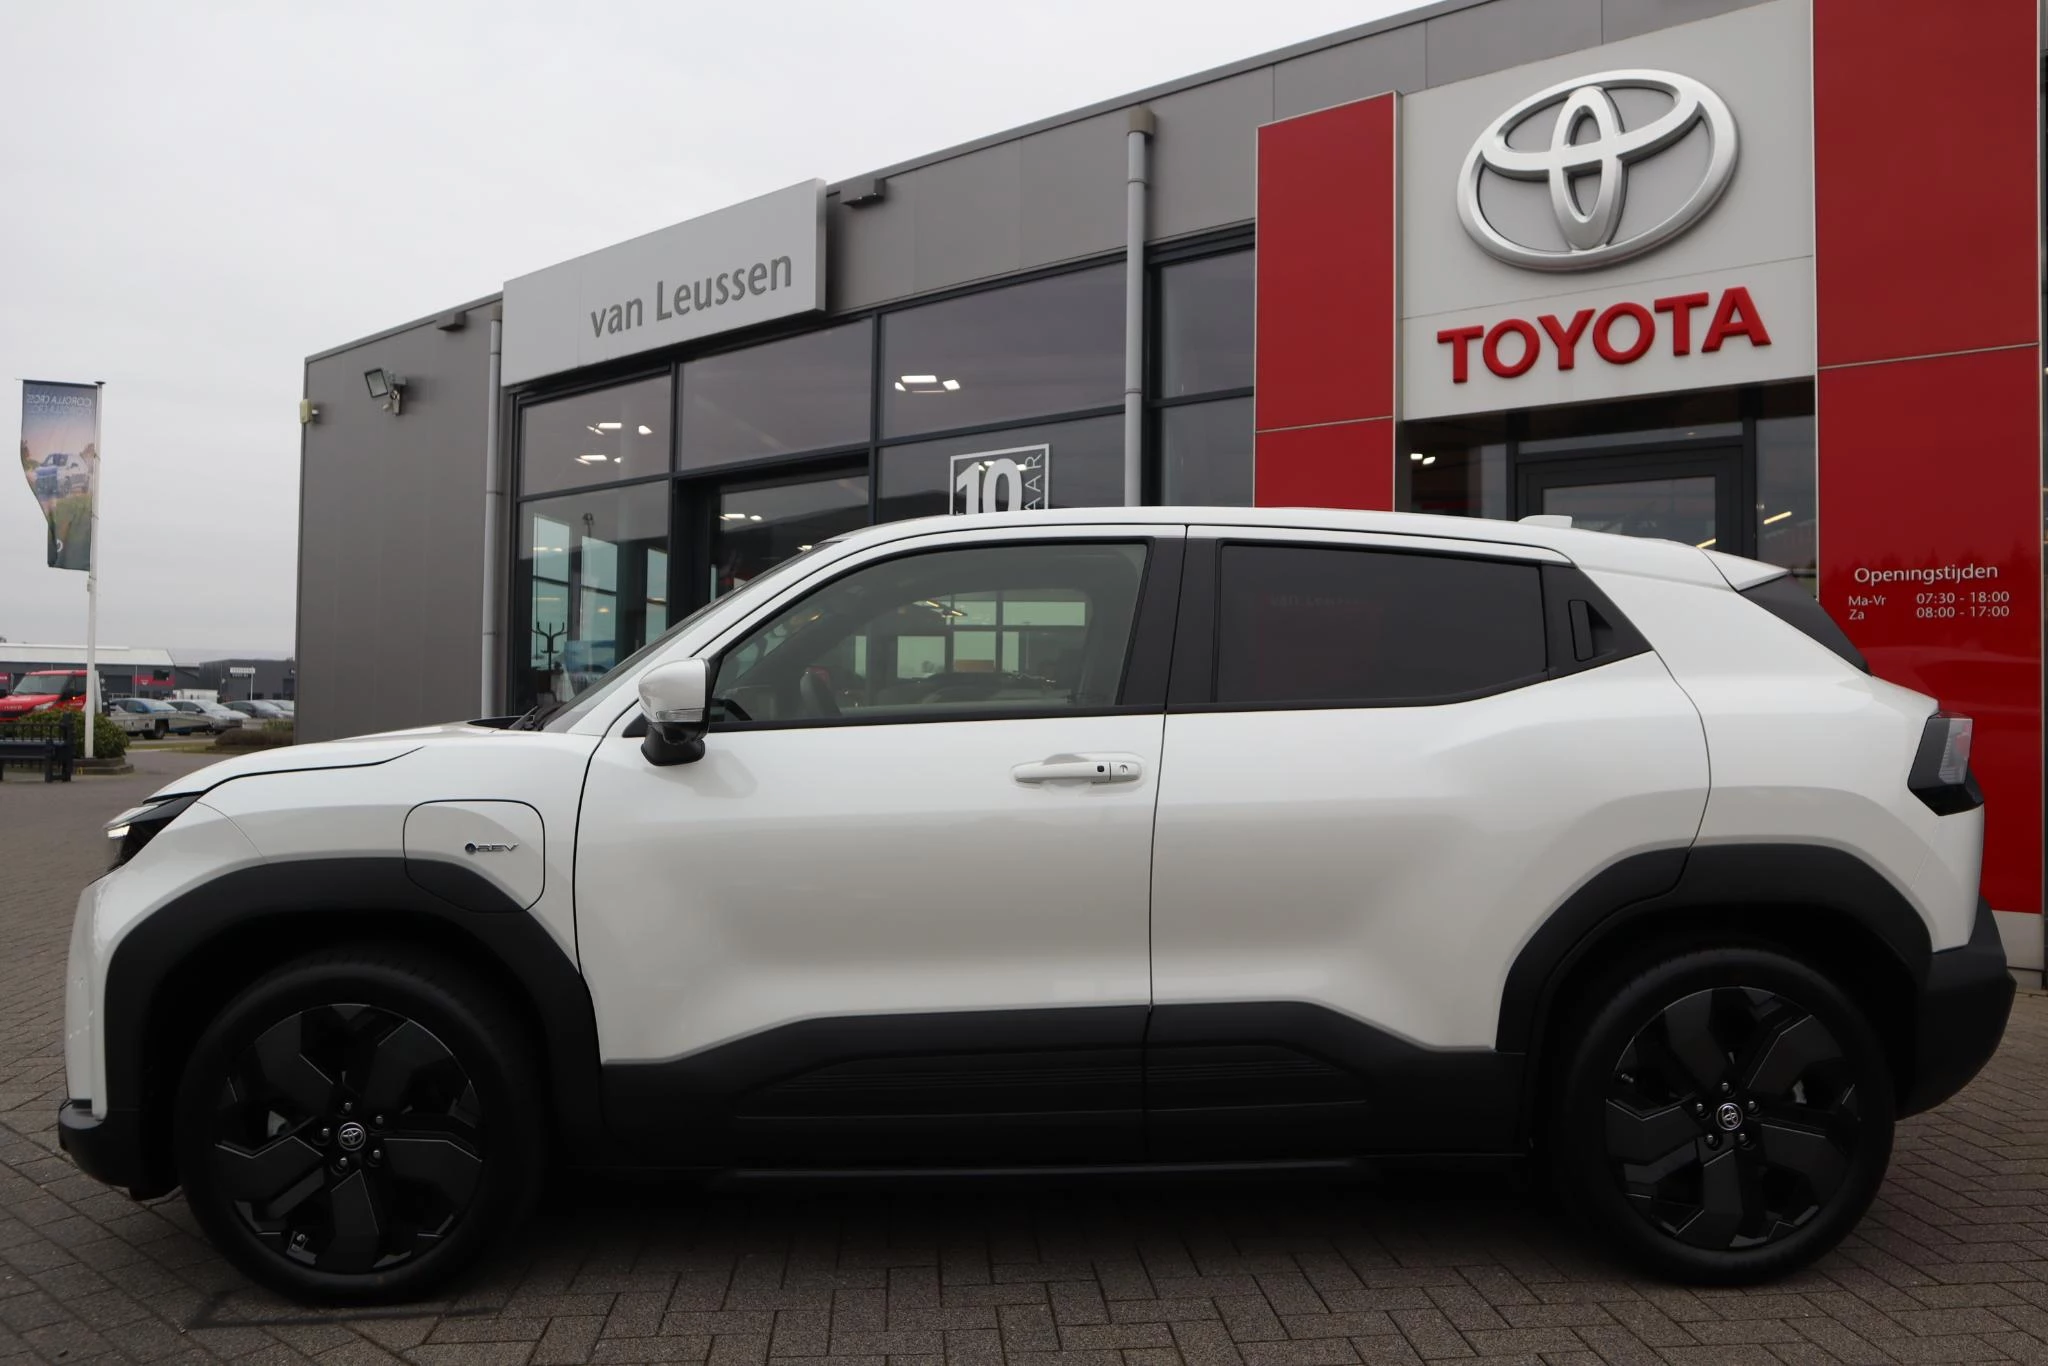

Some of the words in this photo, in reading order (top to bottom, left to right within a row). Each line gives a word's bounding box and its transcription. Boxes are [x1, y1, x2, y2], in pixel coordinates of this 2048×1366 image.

[590, 297, 643, 338] van
[656, 255, 792, 321] Leussen
[1437, 286, 1772, 384] TOYOTA
[956, 458, 1023, 515] 10
[1854, 563, 1998, 587] Openingstijden
[1848, 595, 1886, 606] Ma-Vr
[1916, 592, 1956, 605] 07:30
[1970, 591, 2010, 603] 18:00
[1848, 609, 1865, 620] Za
[1916, 606, 1956, 619] 08:00
[1970, 605, 2010, 617] 17:00
